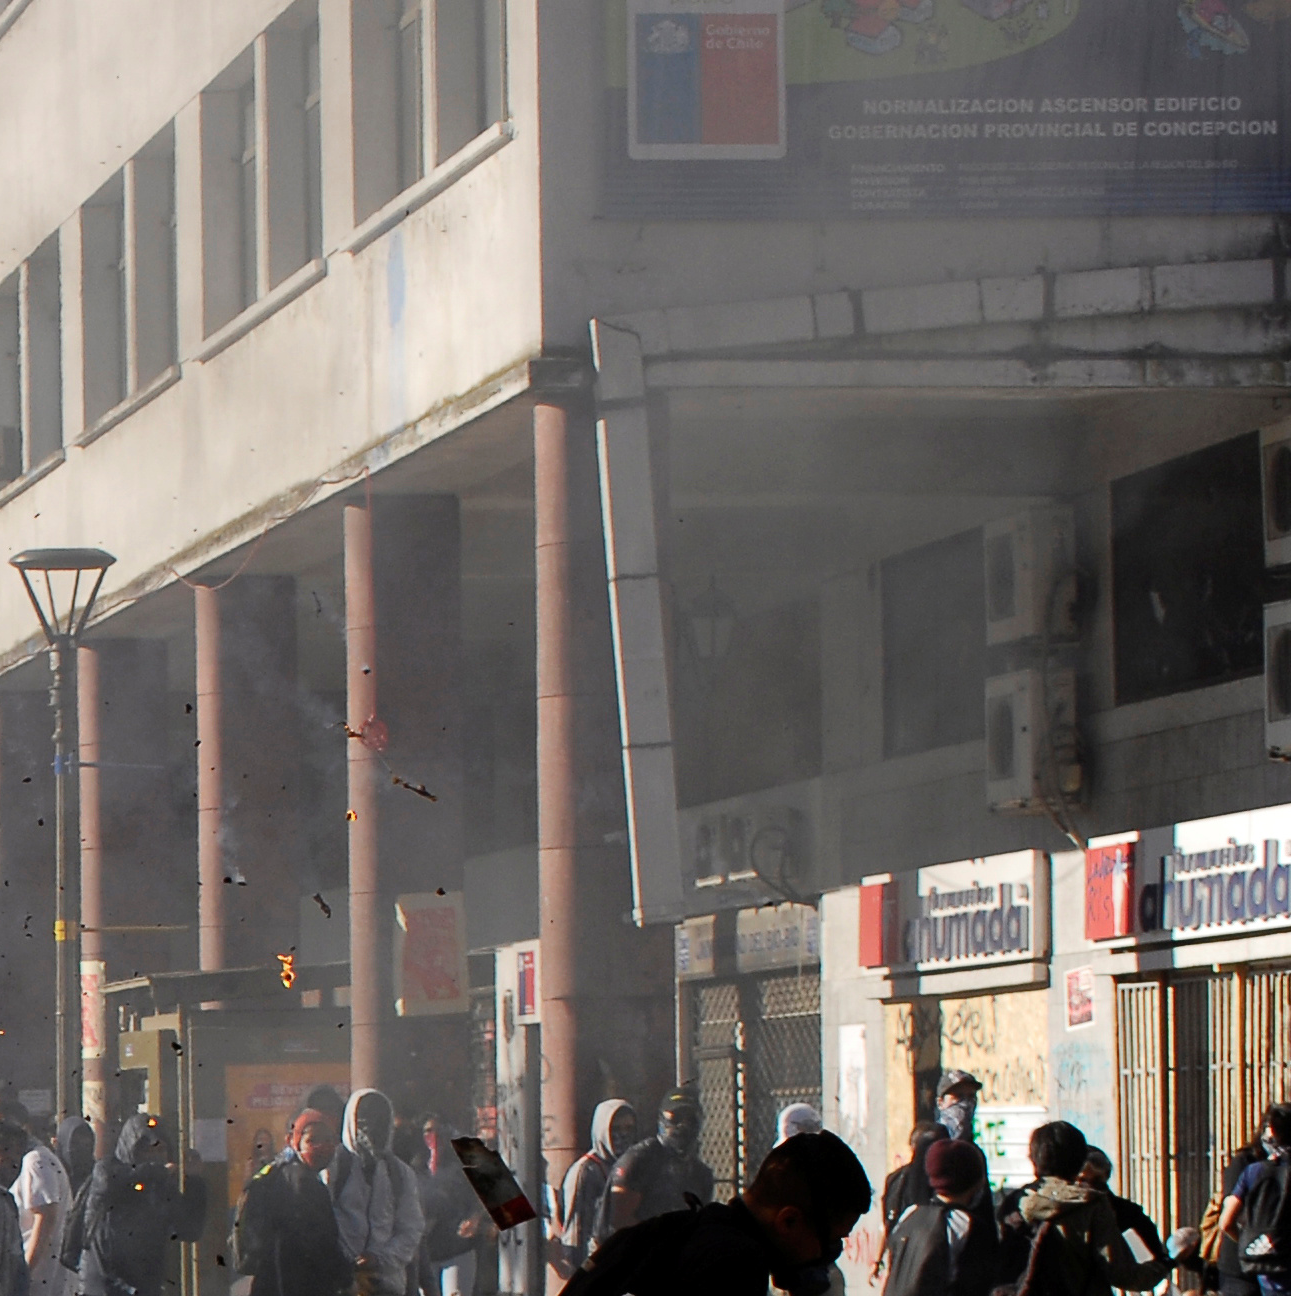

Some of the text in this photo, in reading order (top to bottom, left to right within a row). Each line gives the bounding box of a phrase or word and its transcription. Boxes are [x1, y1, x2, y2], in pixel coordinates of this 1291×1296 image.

[705, 24, 770, 36] Gobierno
[705, 37, 764, 49] de Chile
[862, 96, 1242, 115] NORMALIZACION ASCENSOR EDIFICIO
[828, 120, 1279, 140] GOBERNACION PROVINCIAL DE CONCEPCION
[903, 883, 1029, 963] ahumada
